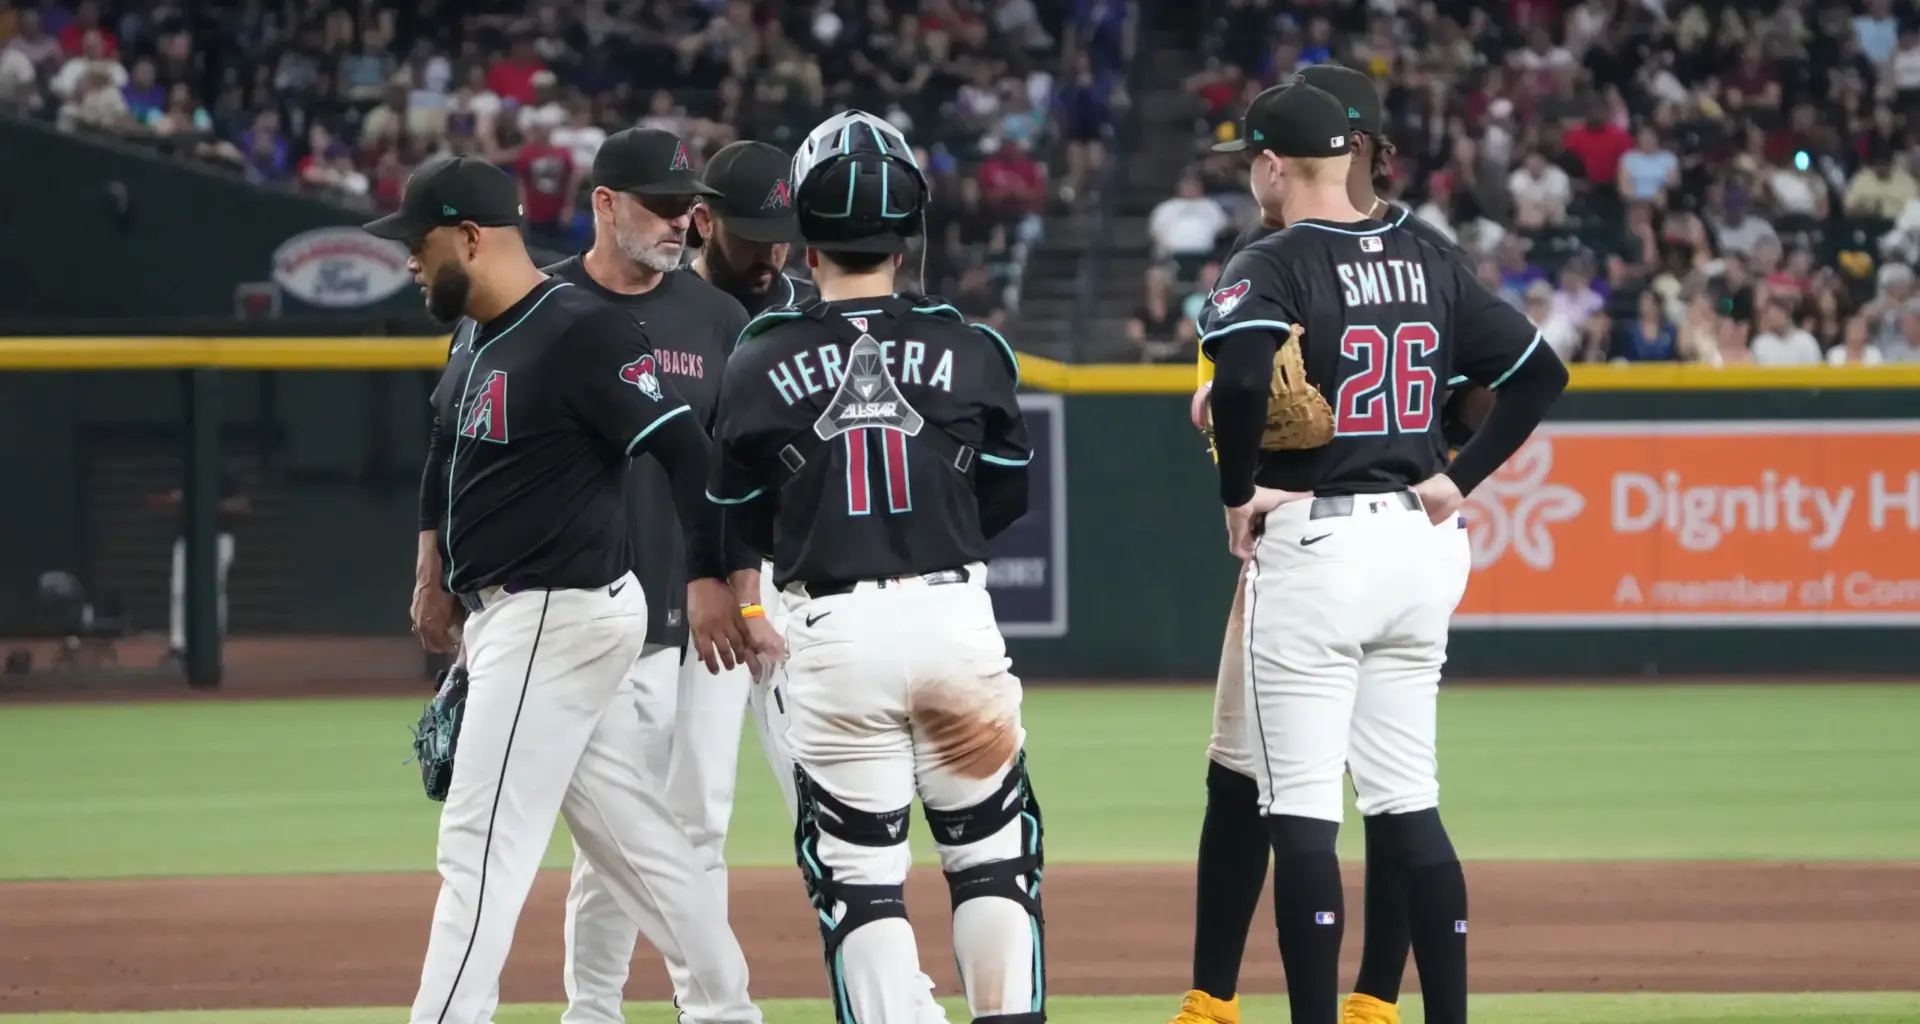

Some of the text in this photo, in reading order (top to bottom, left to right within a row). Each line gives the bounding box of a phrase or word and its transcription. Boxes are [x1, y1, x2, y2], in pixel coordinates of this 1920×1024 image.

[1337, 260, 1427, 307] SMITH
[767, 340, 953, 406] HERERA
[1334, 321, 1440, 437] 26
[839, 401, 898, 420] ALL-STAR
[844, 428, 912, 516] 11
[1611, 469, 1920, 551] Dignity H
[1614, 573, 1644, 606] A
[1652, 573, 1793, 607] member
[1798, 570, 1836, 607] of
